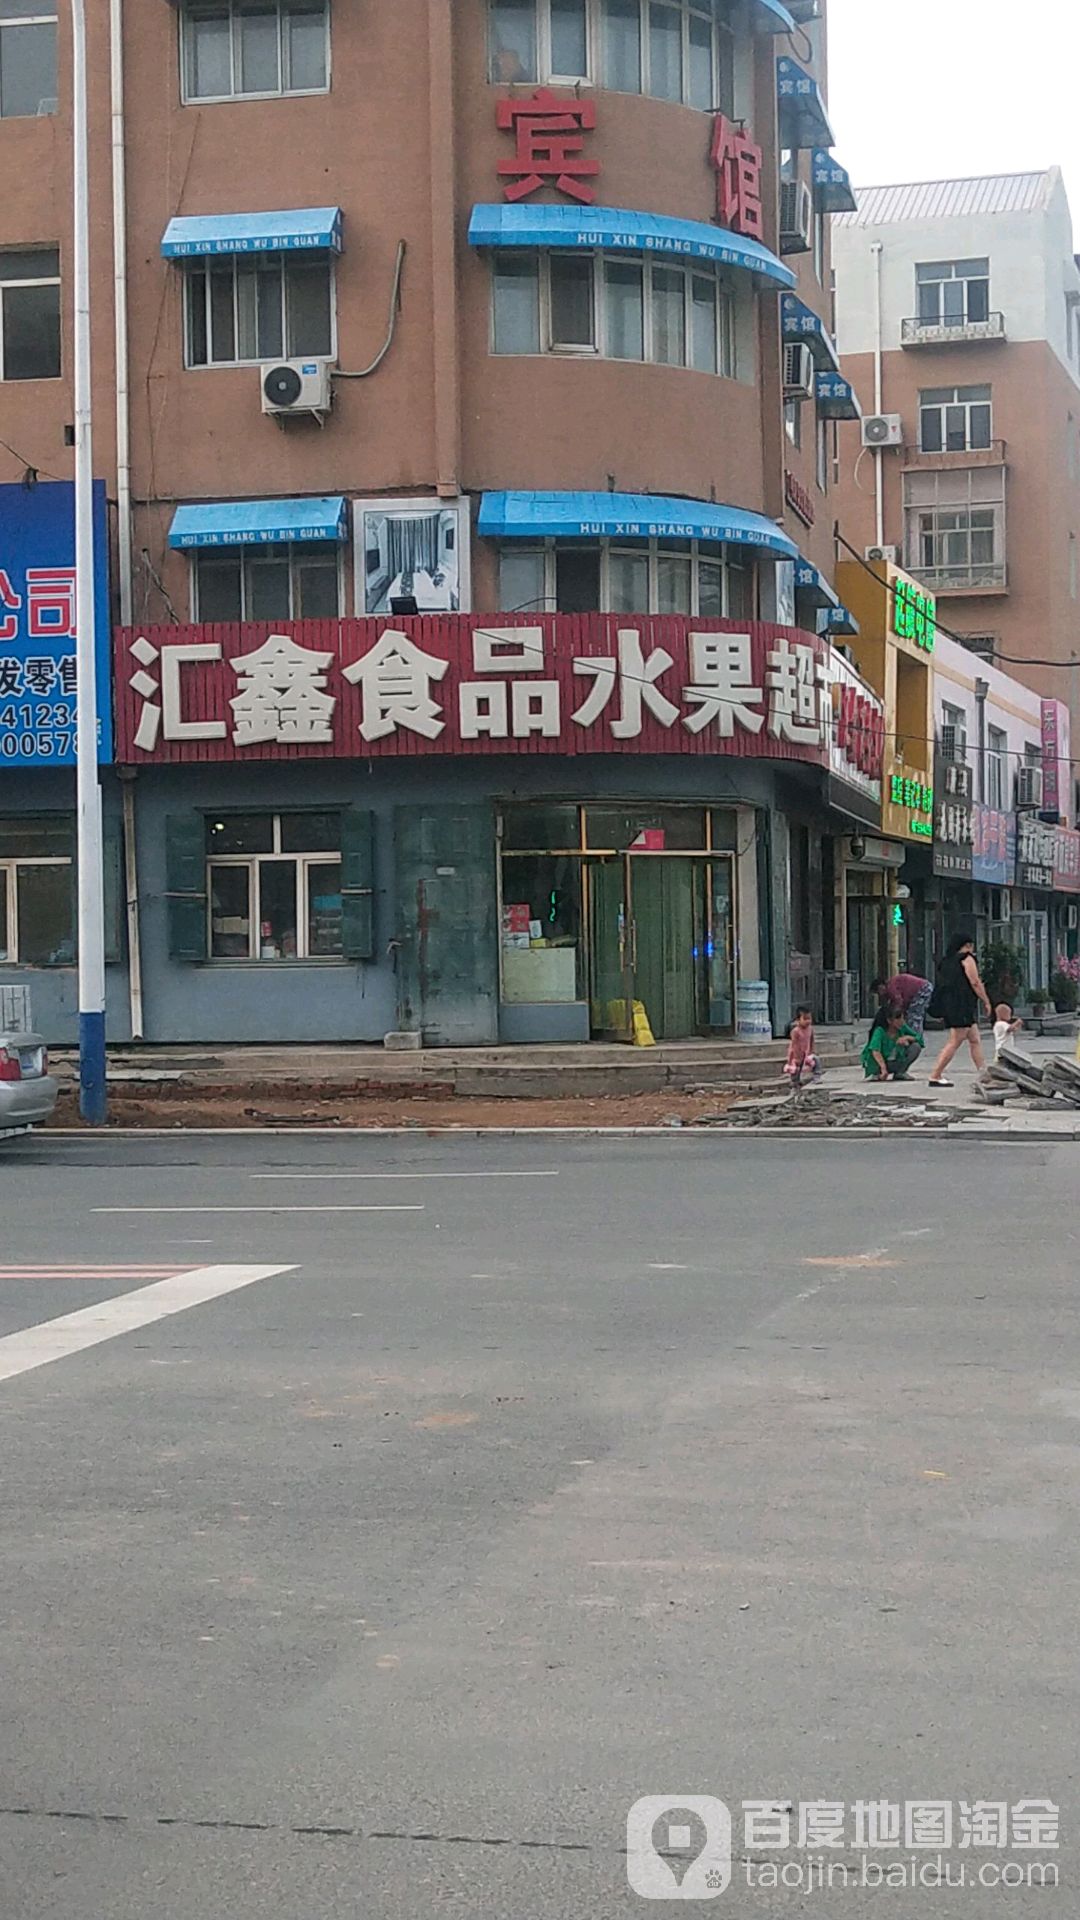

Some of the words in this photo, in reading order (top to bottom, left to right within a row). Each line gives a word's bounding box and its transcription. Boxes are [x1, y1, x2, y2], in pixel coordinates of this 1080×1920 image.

[496, 87, 764, 241] 宾馆
[174, 243, 190, 254] HUI
[195, 242, 211, 252] XIN
[216, 240, 248, 251] SHANG
[254, 239, 267, 248] WU
[272, 237, 288, 247] BIN
[293, 235, 319, 246] GUAN
[577, 233, 602, 244] HUI
[612, 233, 638, 246] XIN
[645, 236, 691, 252] SHANG
[698, 244, 717, 257] WU
[721, 249, 739, 262] BIN
[743, 255, 768, 271] GUAN
[181, 535, 197, 545] HUI
[202, 534, 218, 544] XIN
[223, 532, 255, 542] SHANG
[260, 530, 274, 540] WU
[279, 529, 295, 539] BIN
[300, 528, 326, 538] GUAN
[580, 523, 605, 534] HUI
[615, 524, 640, 534] XIN
[648, 524, 694, 535] SHANG
[701, 526, 719, 537] WU
[724, 527, 742, 538] BIN
[747, 531, 771, 544] GUAN
